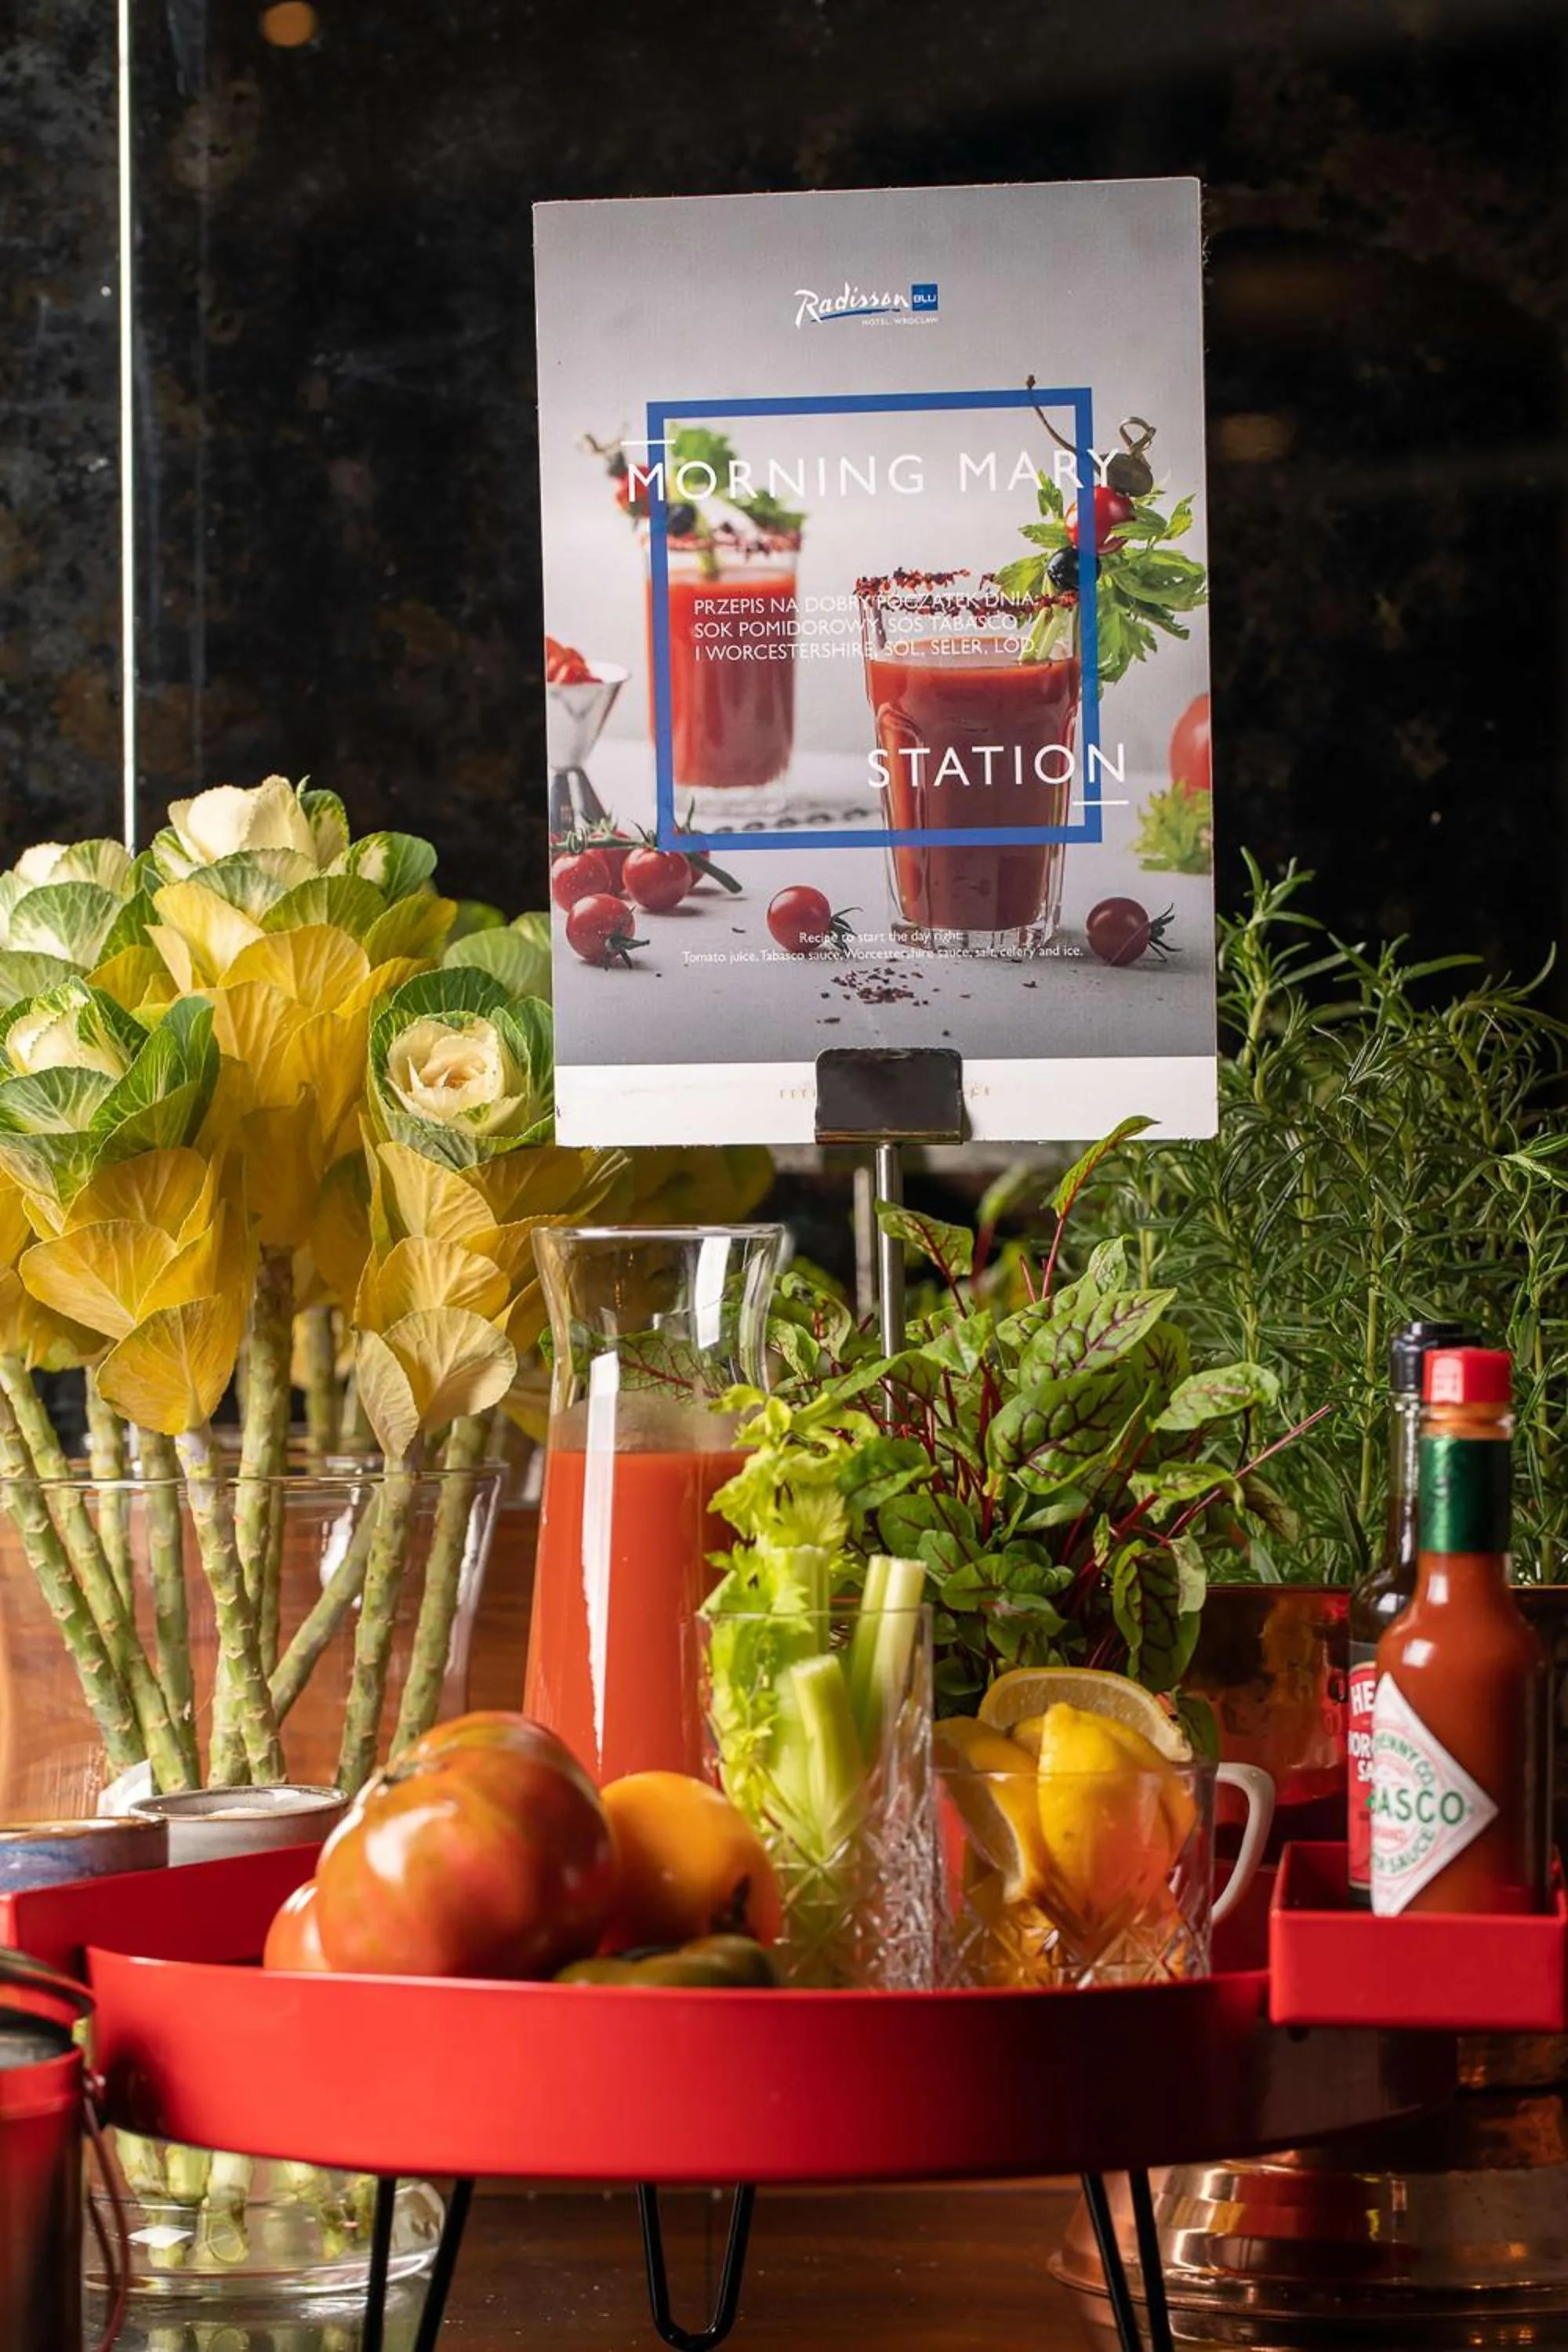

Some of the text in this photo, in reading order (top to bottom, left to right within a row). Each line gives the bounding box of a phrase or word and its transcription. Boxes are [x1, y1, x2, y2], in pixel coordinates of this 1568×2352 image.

[793, 282, 937, 329] Radisson BLU
[627, 448, 1120, 503] MORNING MARY
[693, 598, 765, 615] PRZEPIS
[771, 597, 798, 613] NA
[804, 593, 870, 612] DOBRY
[693, 622, 733, 638] SOK
[887, 617, 924, 633] SOS
[933, 614, 1018, 632] TABASCO
[695, 645, 701, 661] I
[868, 742, 1126, 789] STATION
[800, 931, 838, 946] Recipe
[842, 932, 855, 942] to
[858, 932, 885, 942] start
[889, 931, 907, 942] the
[910, 930, 931, 944] day
[682, 950, 727, 964] Tomato
[760, 948, 805, 961] Tabasco
[844, 946, 934, 960] Worcestershire
[1000, 945, 1036, 960] celery
[1039, 945, 1060, 956] and
[1064, 945, 1083, 956] ice.
[1377, 1788, 1465, 1825] ASCO
